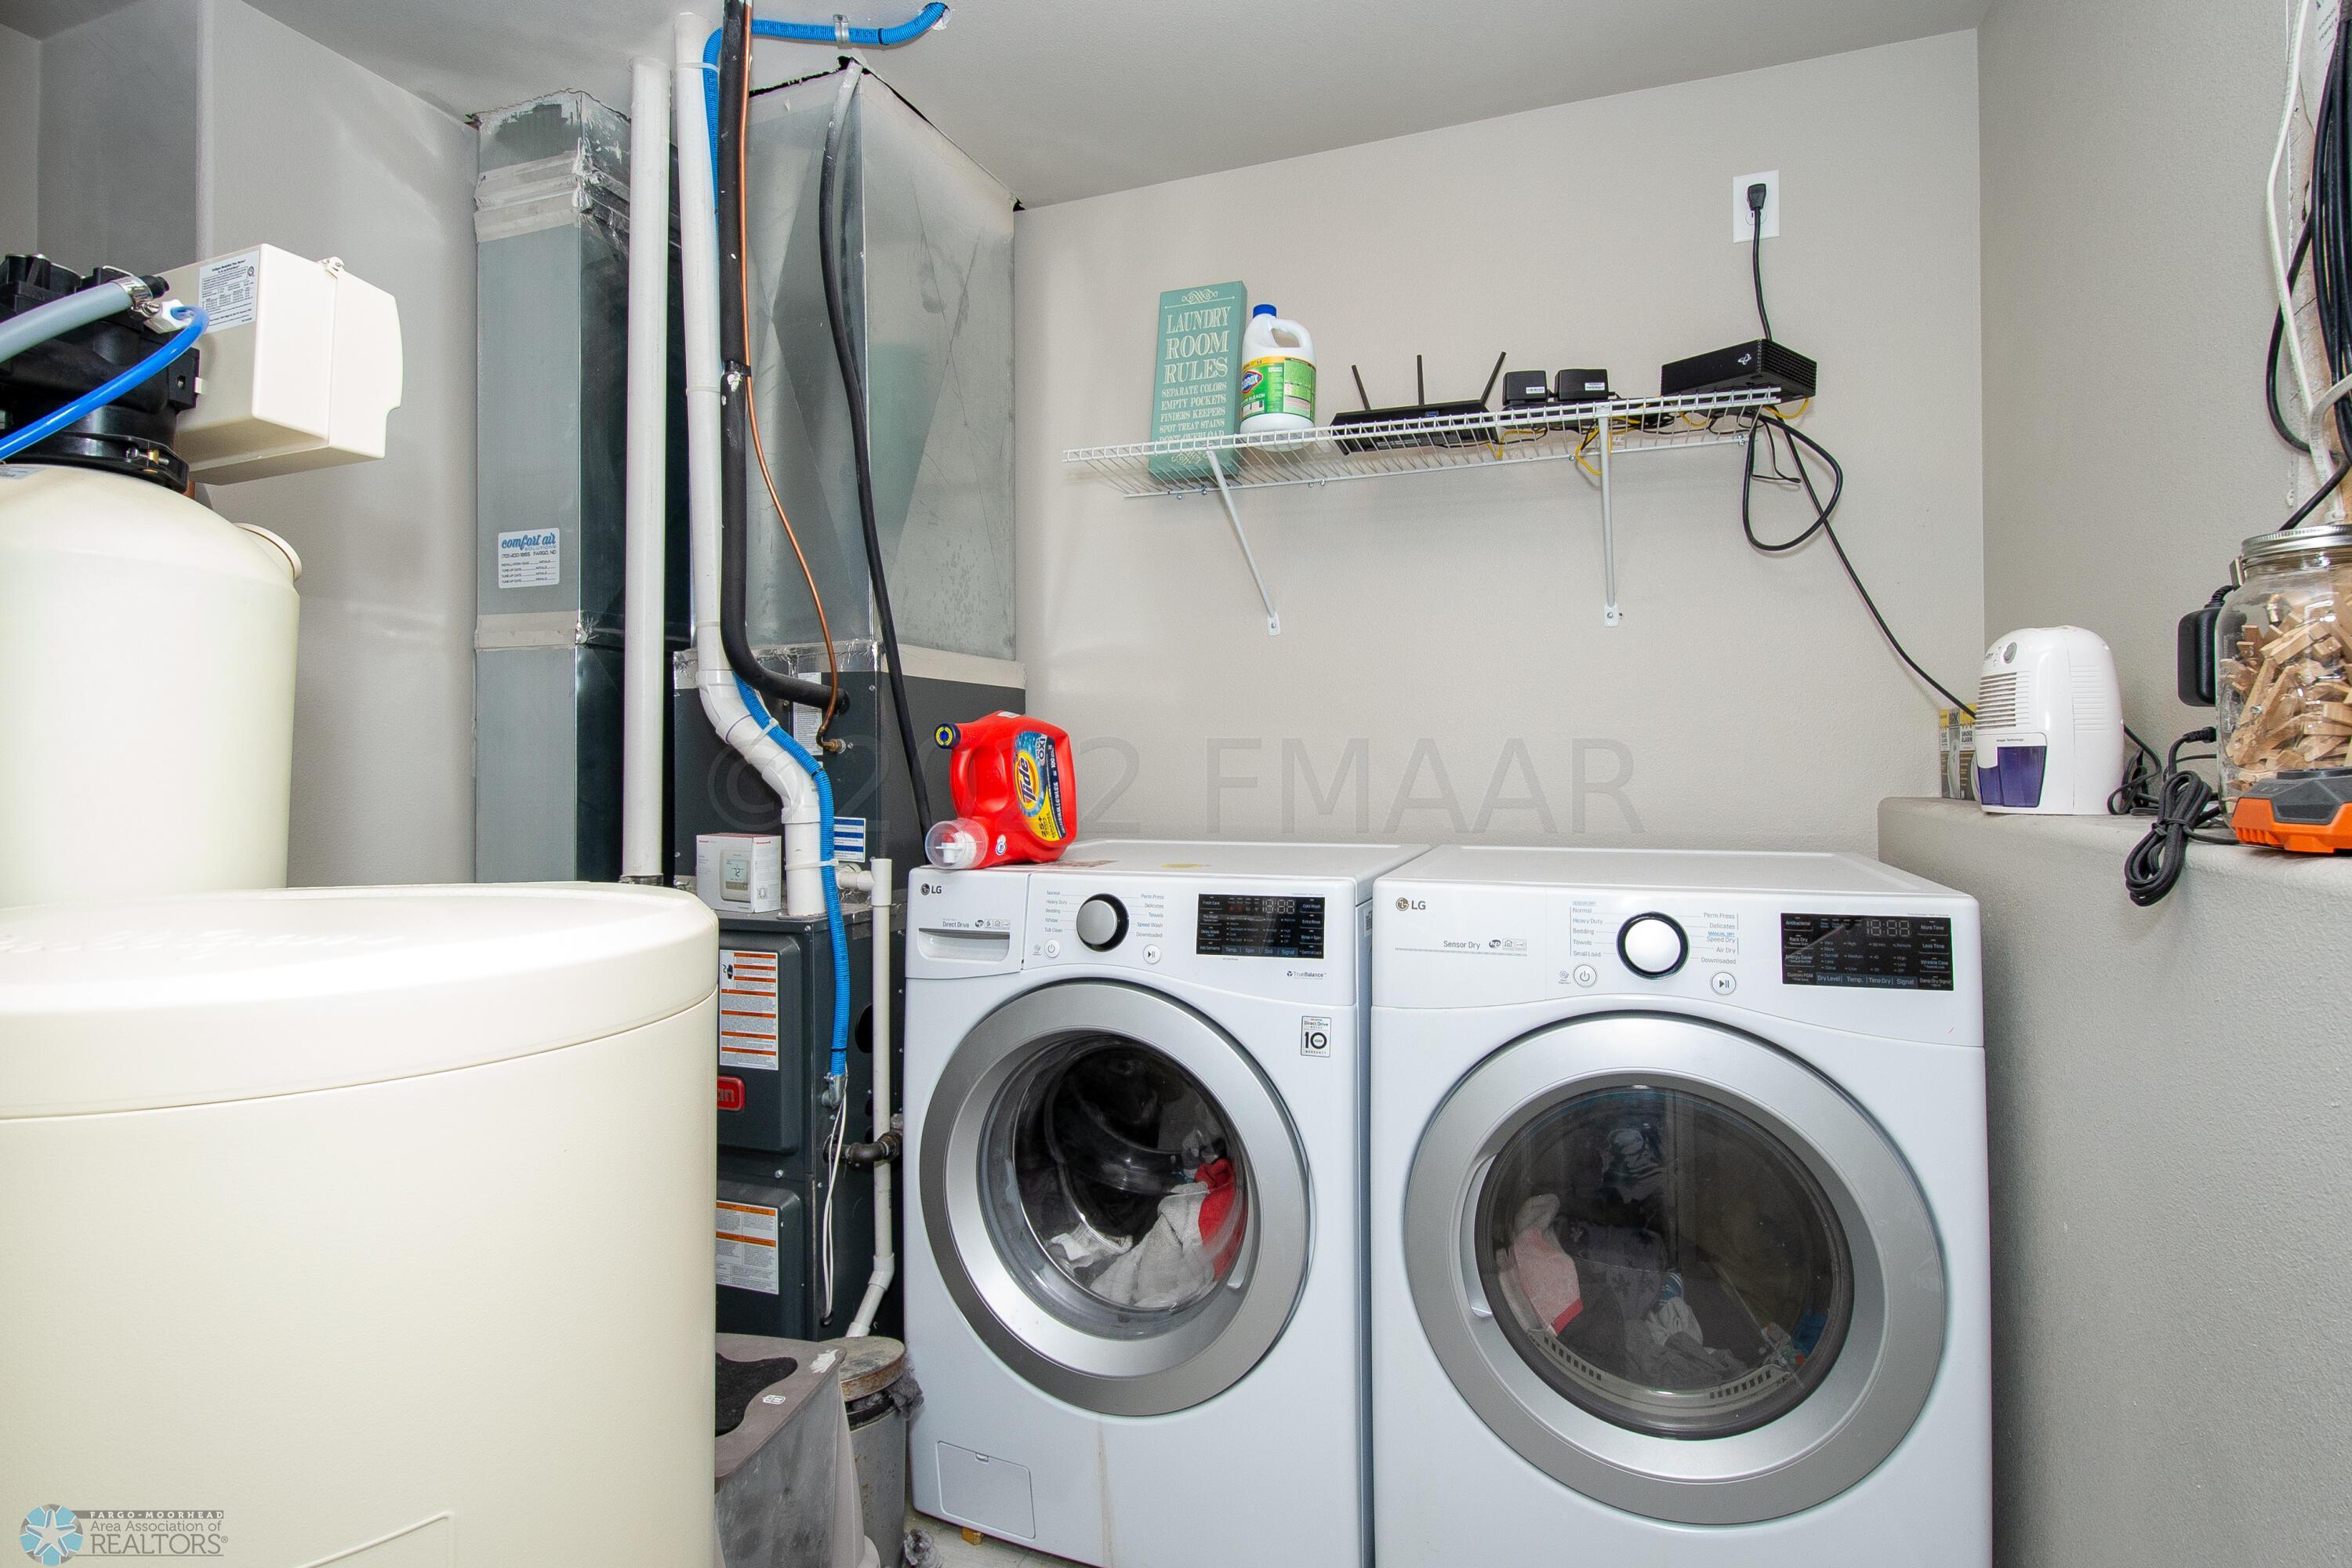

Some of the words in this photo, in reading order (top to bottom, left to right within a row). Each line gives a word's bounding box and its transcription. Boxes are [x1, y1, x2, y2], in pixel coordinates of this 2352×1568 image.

[1167, 307, 1232, 334] LAUNDRY
[1166, 331, 1229, 360] ROOM
[1163, 358, 1228, 384] RULES
[1162, 385, 1199, 398] SEPARATE
[1200, 382, 1227, 393] COLORS
[1161, 398, 1189, 411] EMPTY
[1191, 394, 1226, 407] POCKETS
[1160, 410, 1190, 423] FINDERS
[1192, 407, 1226, 419] KEEPERS
[1159, 423, 1176, 434] SPOT
[1178, 421, 1200, 431] TREAT
[1200, 419, 1225, 429] STAINS
[502, 534, 543, 550] comfort
[542, 532, 557, 546] air
[1018, 757, 1037, 804] Tide
[931, 885, 942, 894] LG
[1411, 900, 1426, 910] LG
[1443, 940, 1467, 949] Sensor
[1468, 940, 1481, 950] Dry
[1305, 1031, 1327, 1049] 10
